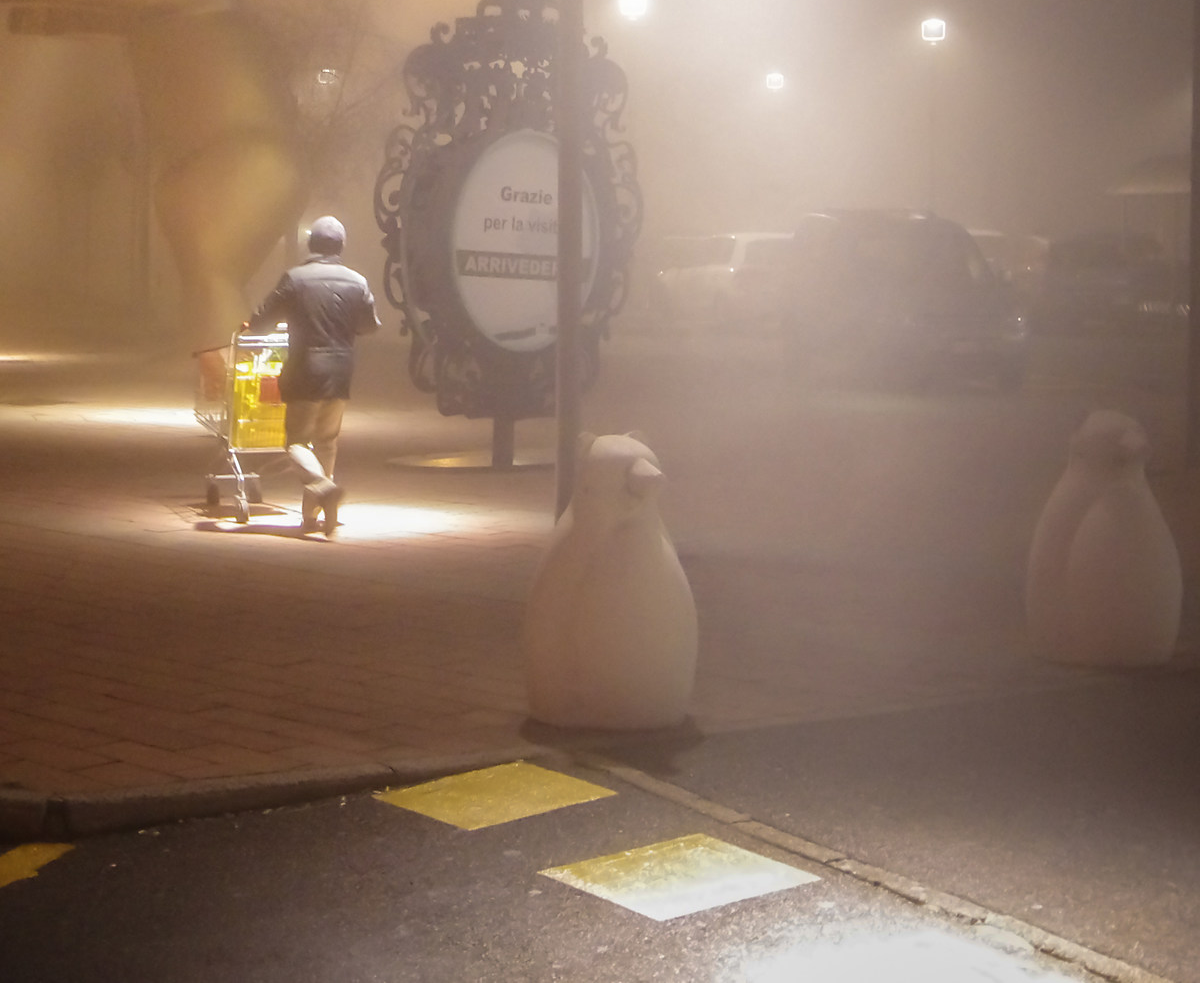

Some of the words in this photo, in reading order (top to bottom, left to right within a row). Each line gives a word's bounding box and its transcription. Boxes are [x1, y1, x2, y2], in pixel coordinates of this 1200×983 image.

[500, 186, 553, 205] Grazie
[484, 217, 507, 233] per
[511, 216, 524, 232] la
[528, 219, 558, 234] visit
